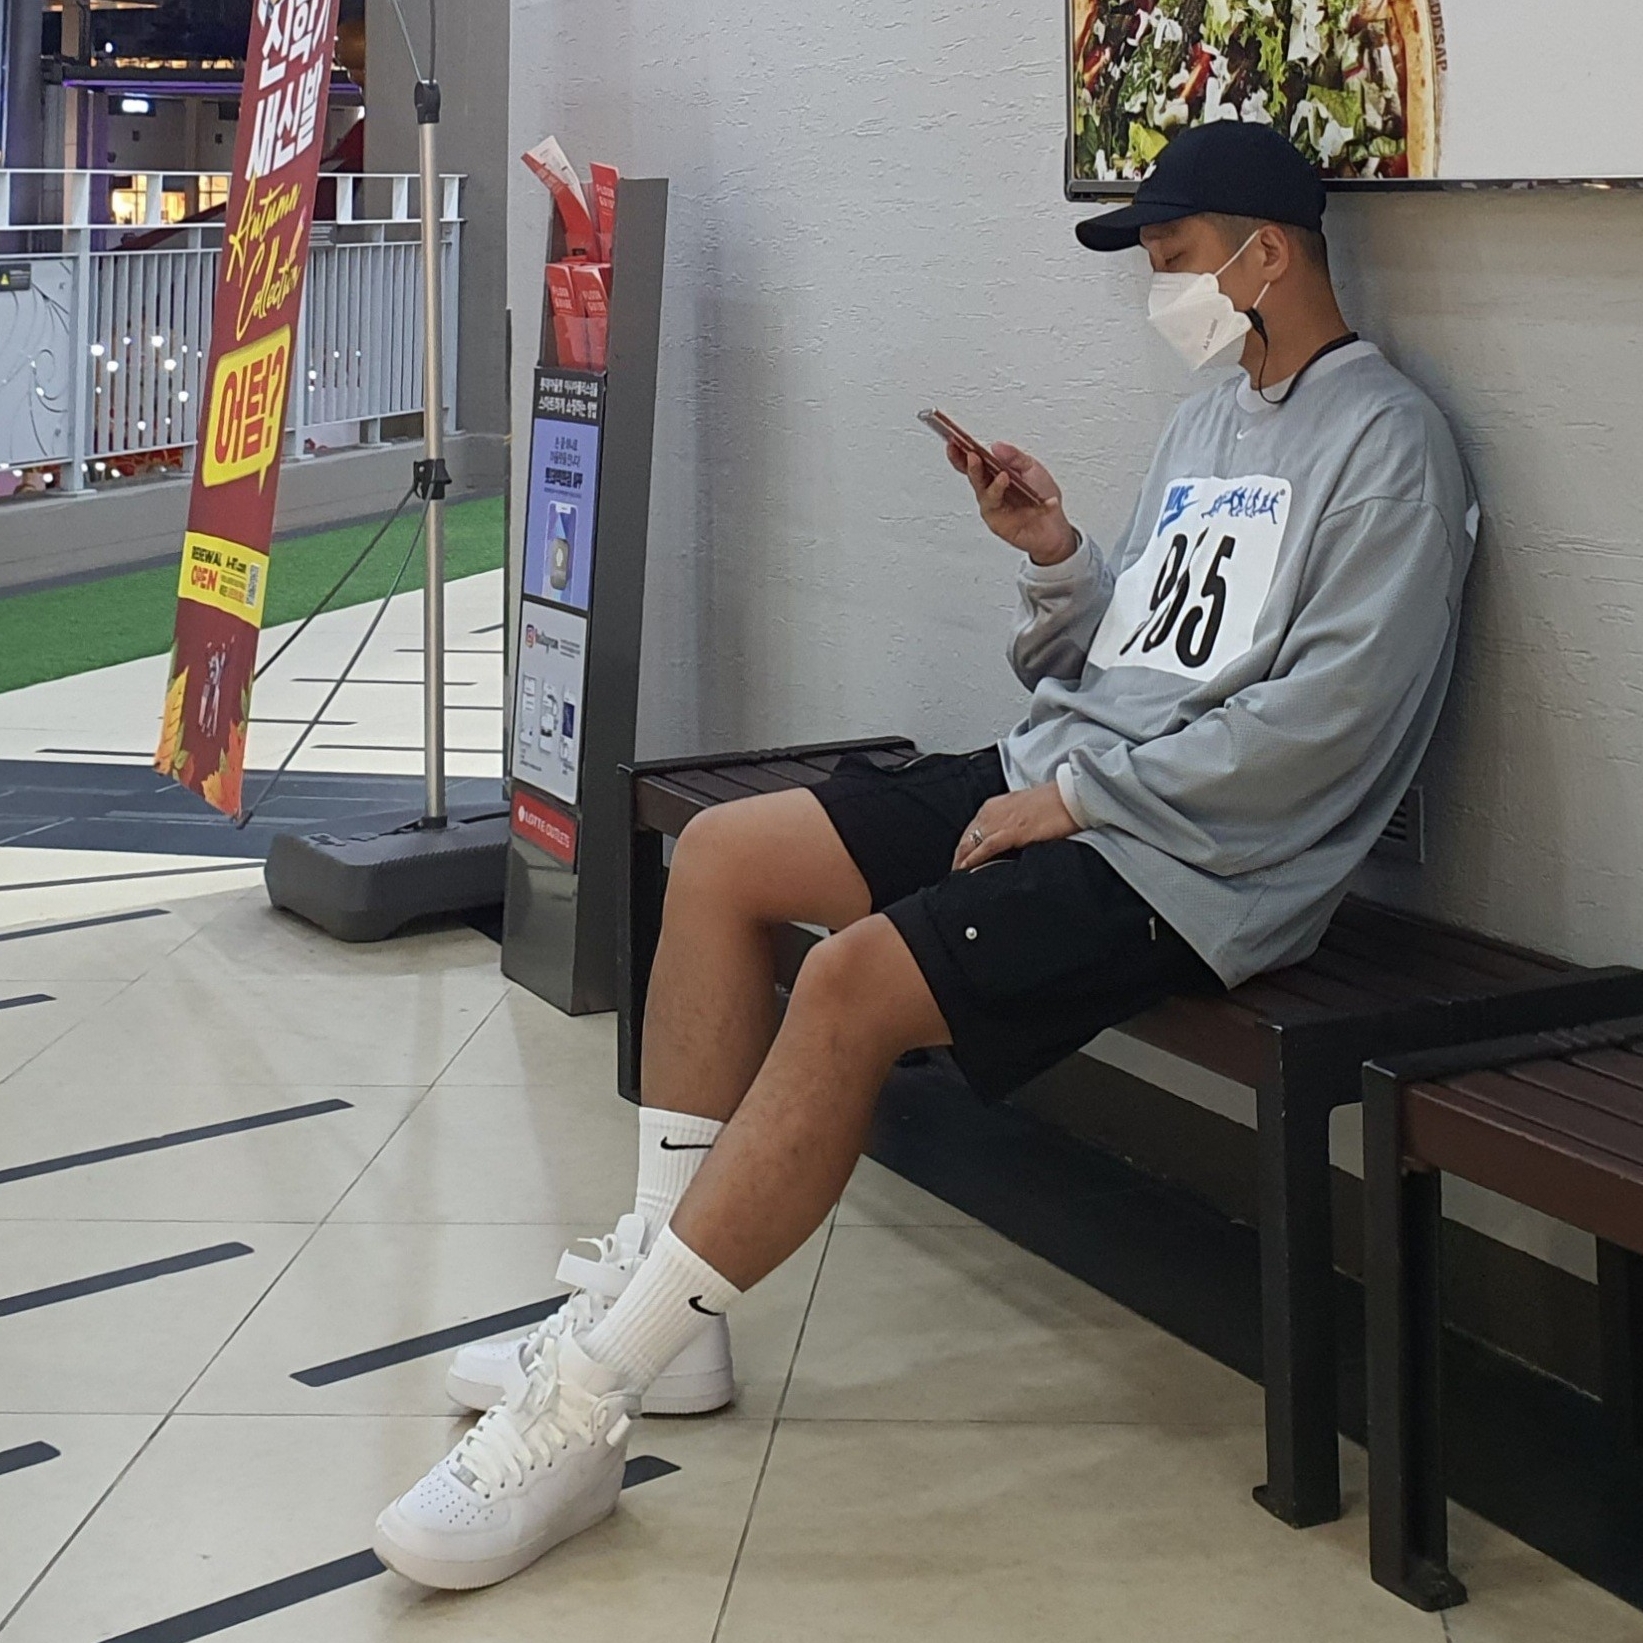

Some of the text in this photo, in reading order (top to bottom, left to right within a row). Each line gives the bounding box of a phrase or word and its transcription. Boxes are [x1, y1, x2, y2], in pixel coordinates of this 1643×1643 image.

[245, 54, 323, 181] 새신발
[226, 172, 302, 287] Autumn
[214, 344, 285, 465] 어텀?
[190, 565, 218, 592] OPEN
[1119, 526, 1236, 669] 965
[525, 811, 546, 833] LOTTE
